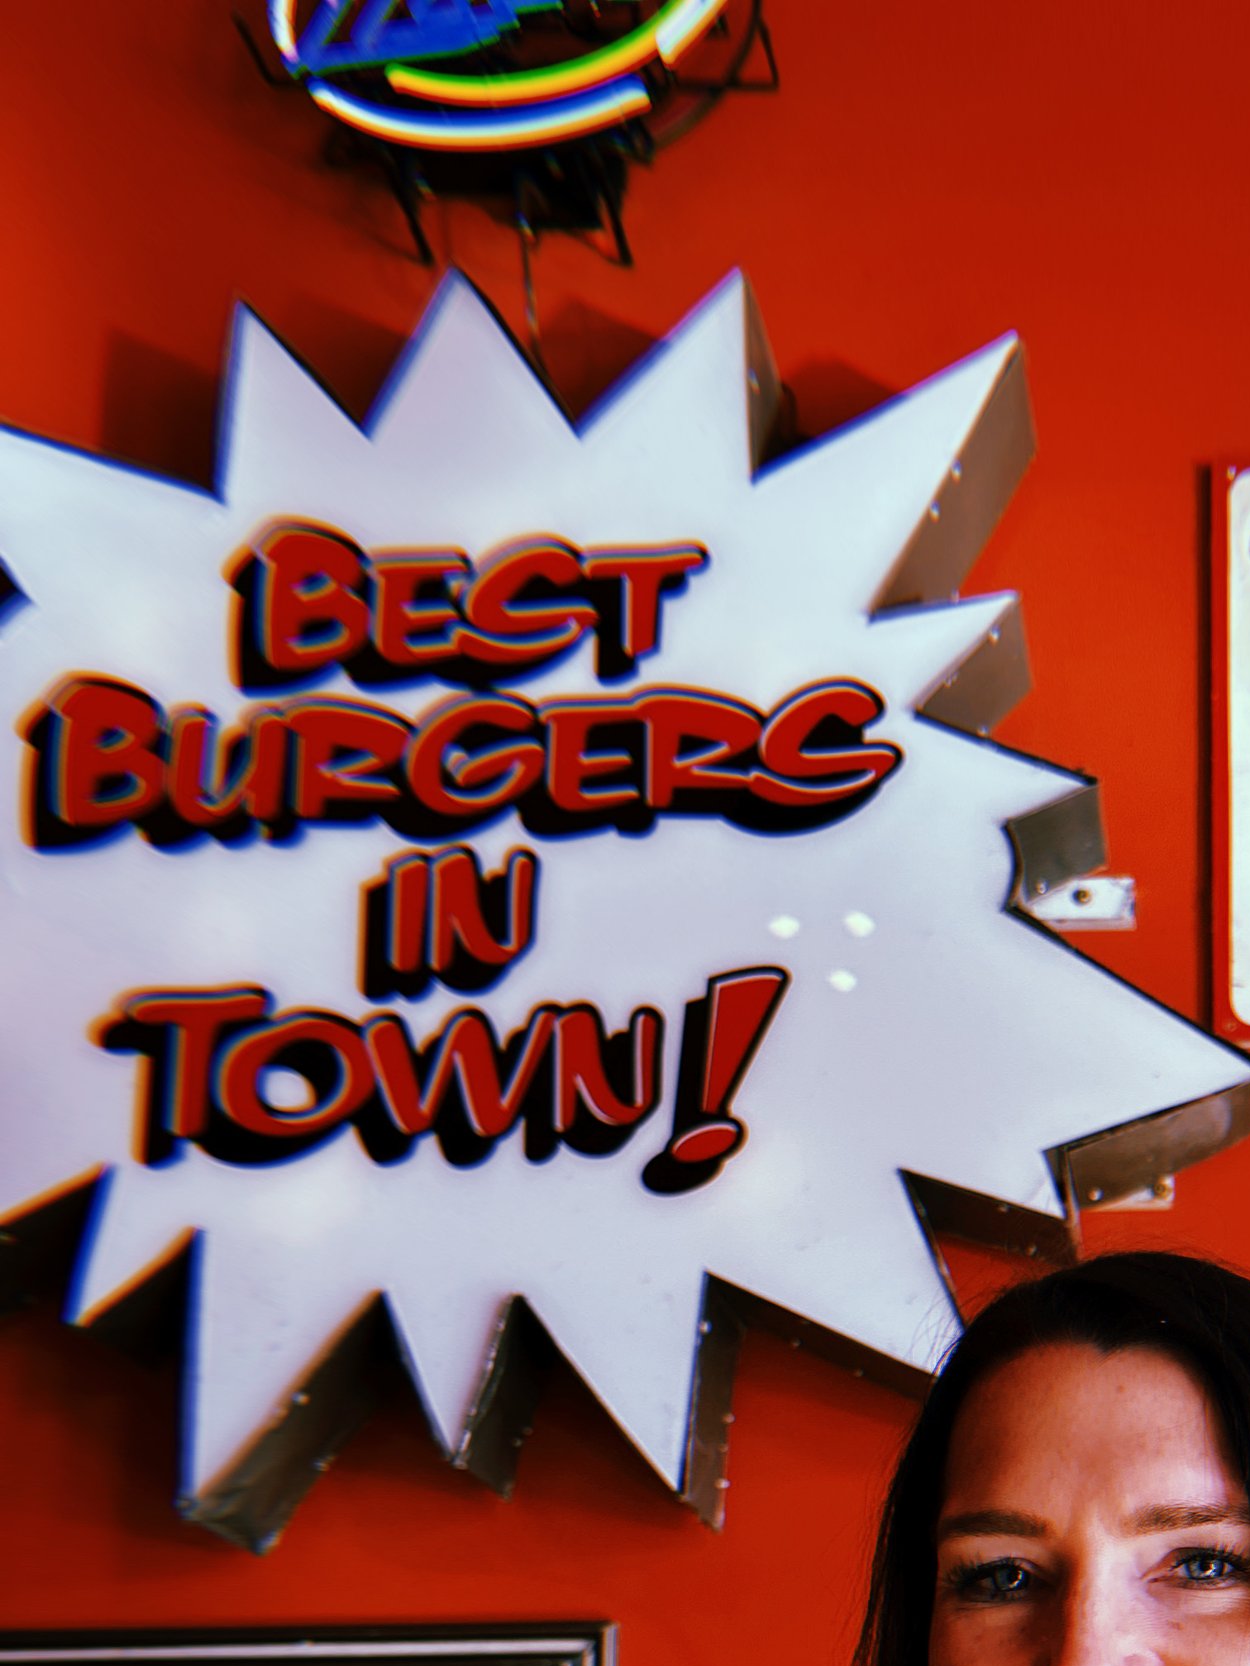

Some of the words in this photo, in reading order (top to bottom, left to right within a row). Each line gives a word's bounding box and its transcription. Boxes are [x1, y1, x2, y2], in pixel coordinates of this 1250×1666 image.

[221, 513, 711, 695] BEST
[16, 669, 903, 853] BURGERS
[358, 844, 540, 1002] IN
[87, 964, 791, 1194] TOWN!
